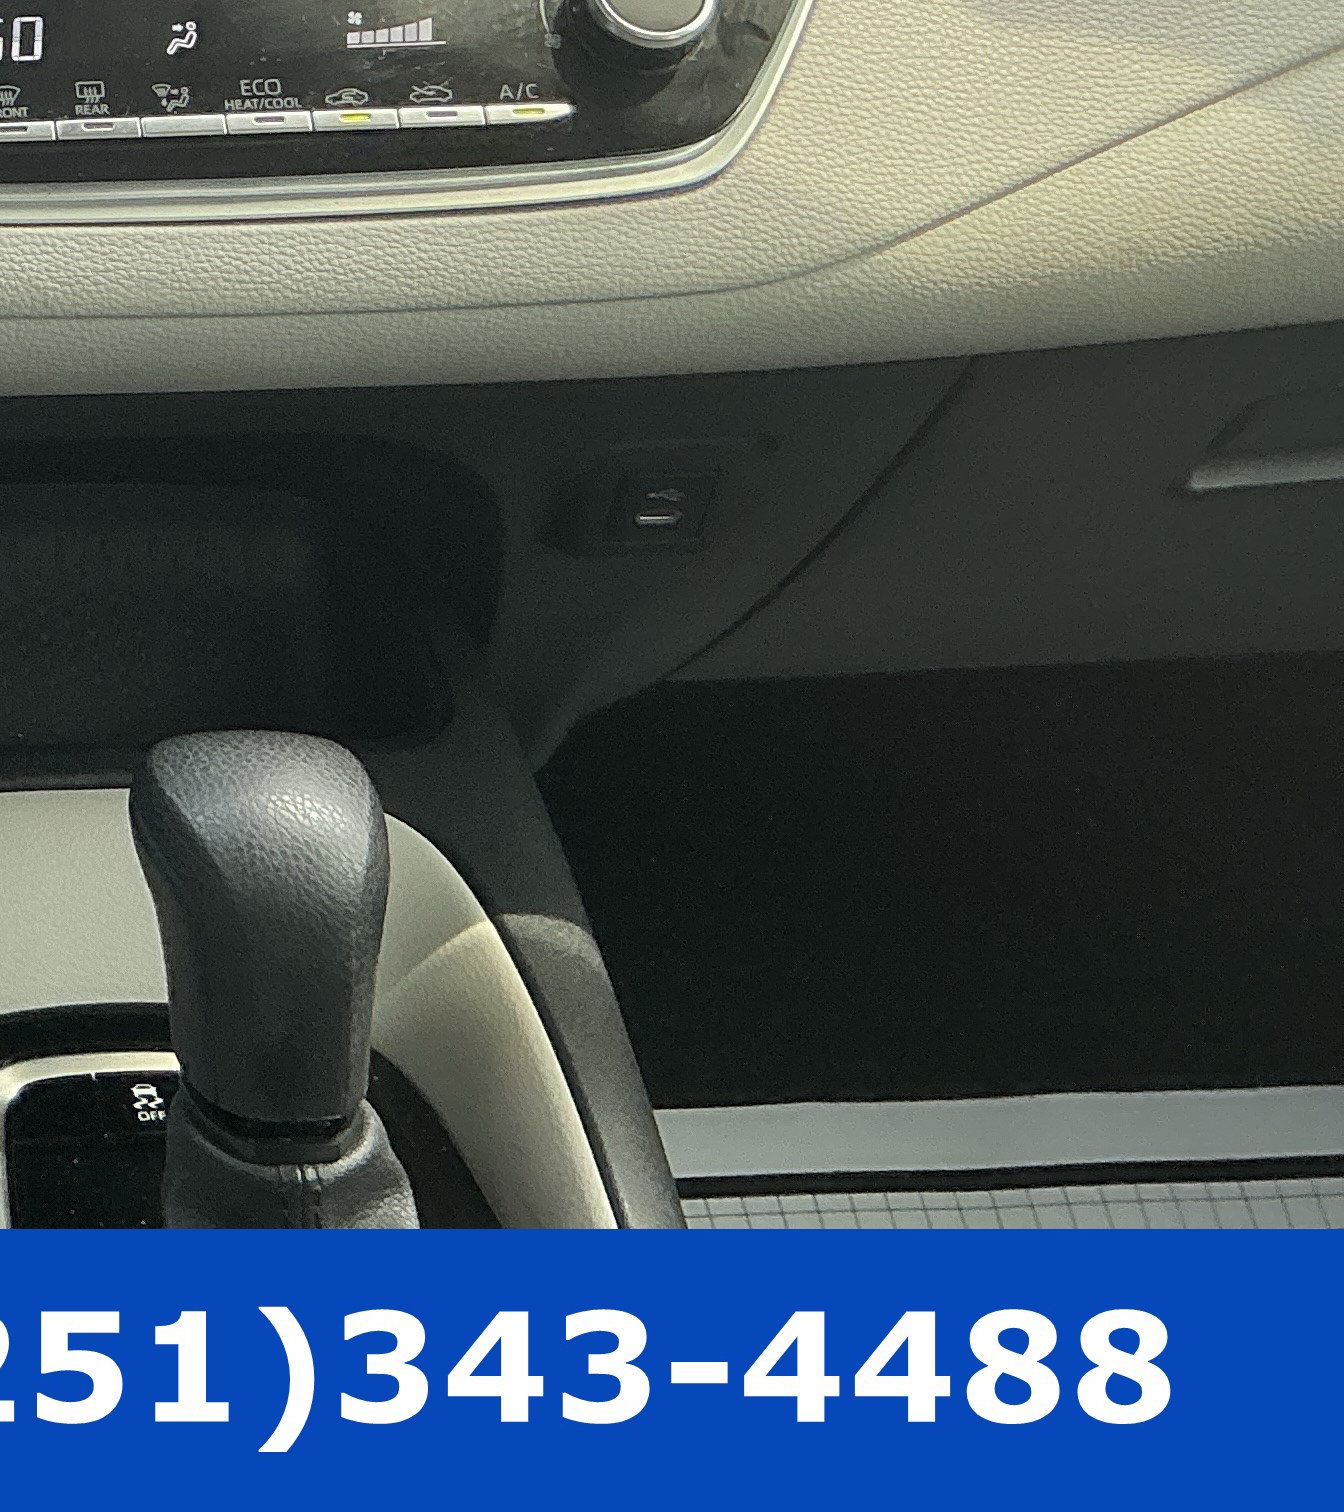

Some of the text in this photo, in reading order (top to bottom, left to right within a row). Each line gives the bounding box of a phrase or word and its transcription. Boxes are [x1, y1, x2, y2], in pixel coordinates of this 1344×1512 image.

[239, 78, 283, 96] ECO
[499, 82, 540, 101] A/C
[74, 102, 111, 116] REAR
[224, 97, 303, 111] HEAT/COOL
[137, 1110, 167, 1122] OFF
